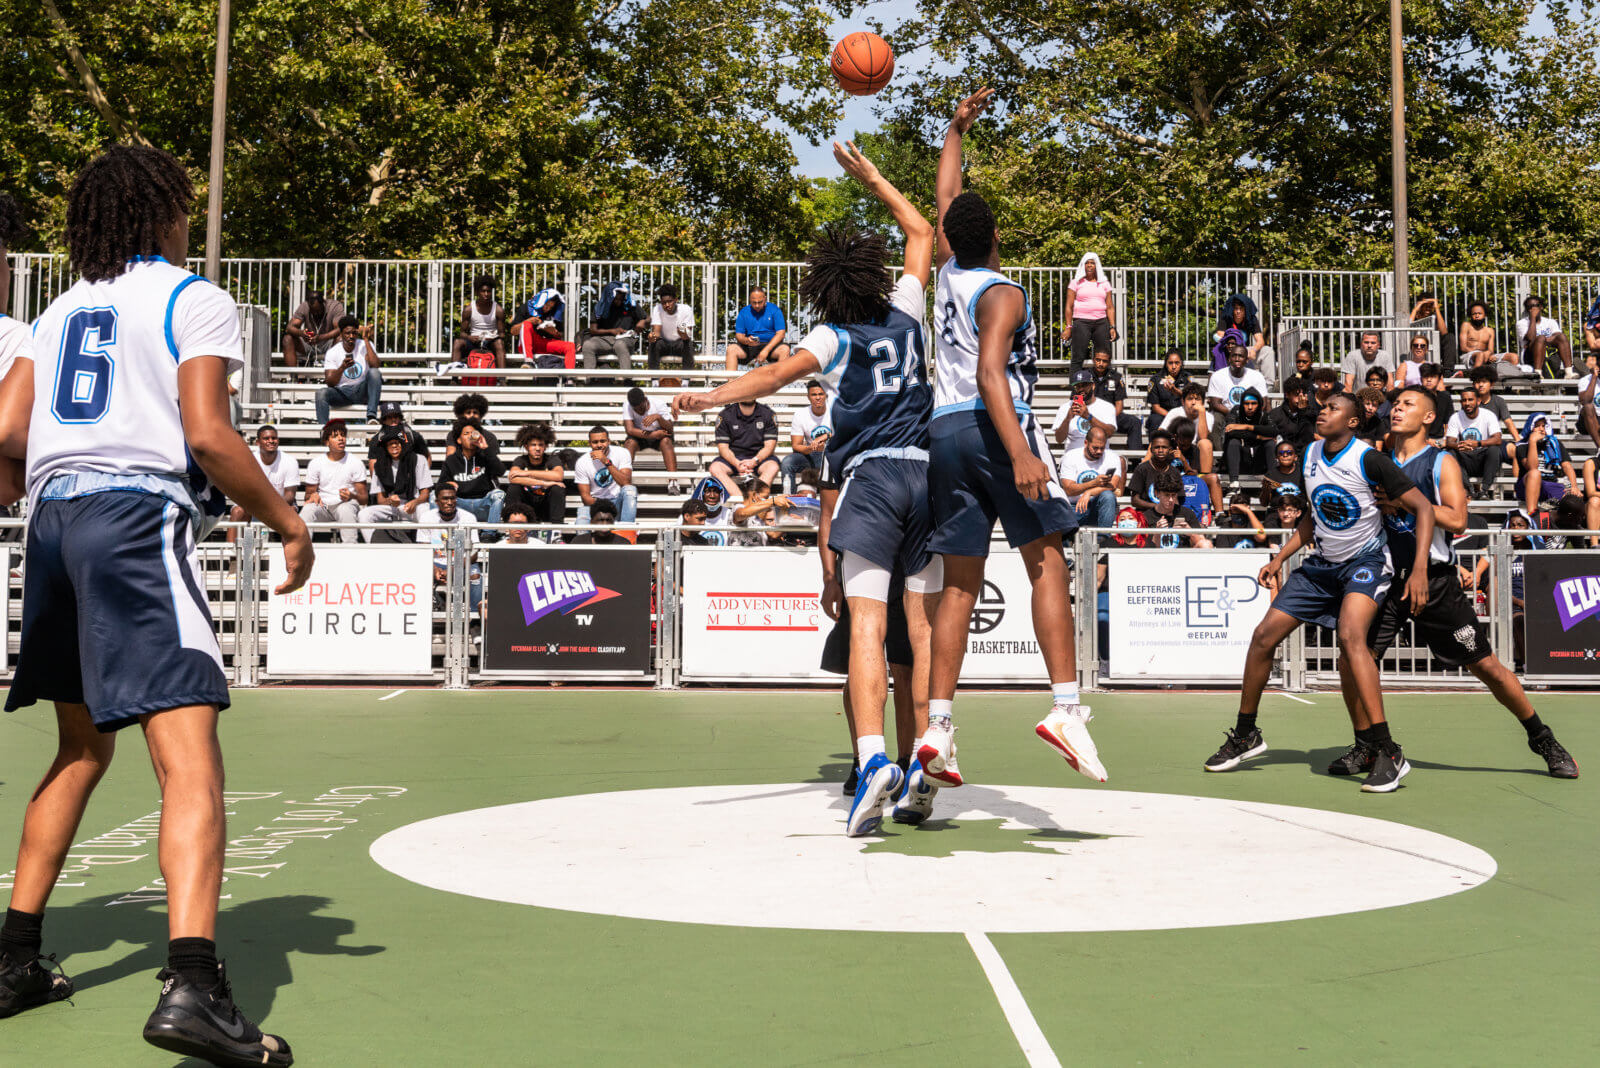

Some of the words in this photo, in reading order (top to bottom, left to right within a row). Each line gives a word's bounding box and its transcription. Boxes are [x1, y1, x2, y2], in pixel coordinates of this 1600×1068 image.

[51, 305, 119, 424] 6
[867, 329, 921, 395] 24
[284, 594, 305, 605] THE
[309, 583, 416, 605] PLAYERS
[525, 571, 596, 612] CLASH
[1127, 585, 1181, 594] ELEFTERAKIS
[708, 598, 739, 610] ADD
[743, 598, 819, 611] VENTURES
[1127, 596, 1181, 605] ELEFTERAKIS
[1560, 577, 1600, 618] CLA
[1154, 607, 1181, 615] PANEK
[282, 612, 417, 635] CIRCLE
[575, 614, 594, 626] TV
[707, 614, 819, 626] MUSIC
[1187, 631, 1228, 640] @EEPLAW
[972, 641, 1039, 654] BASKETBALL
[283, 786, 408, 807] City
[271, 810, 359, 824] of
[223, 826, 346, 860] New
